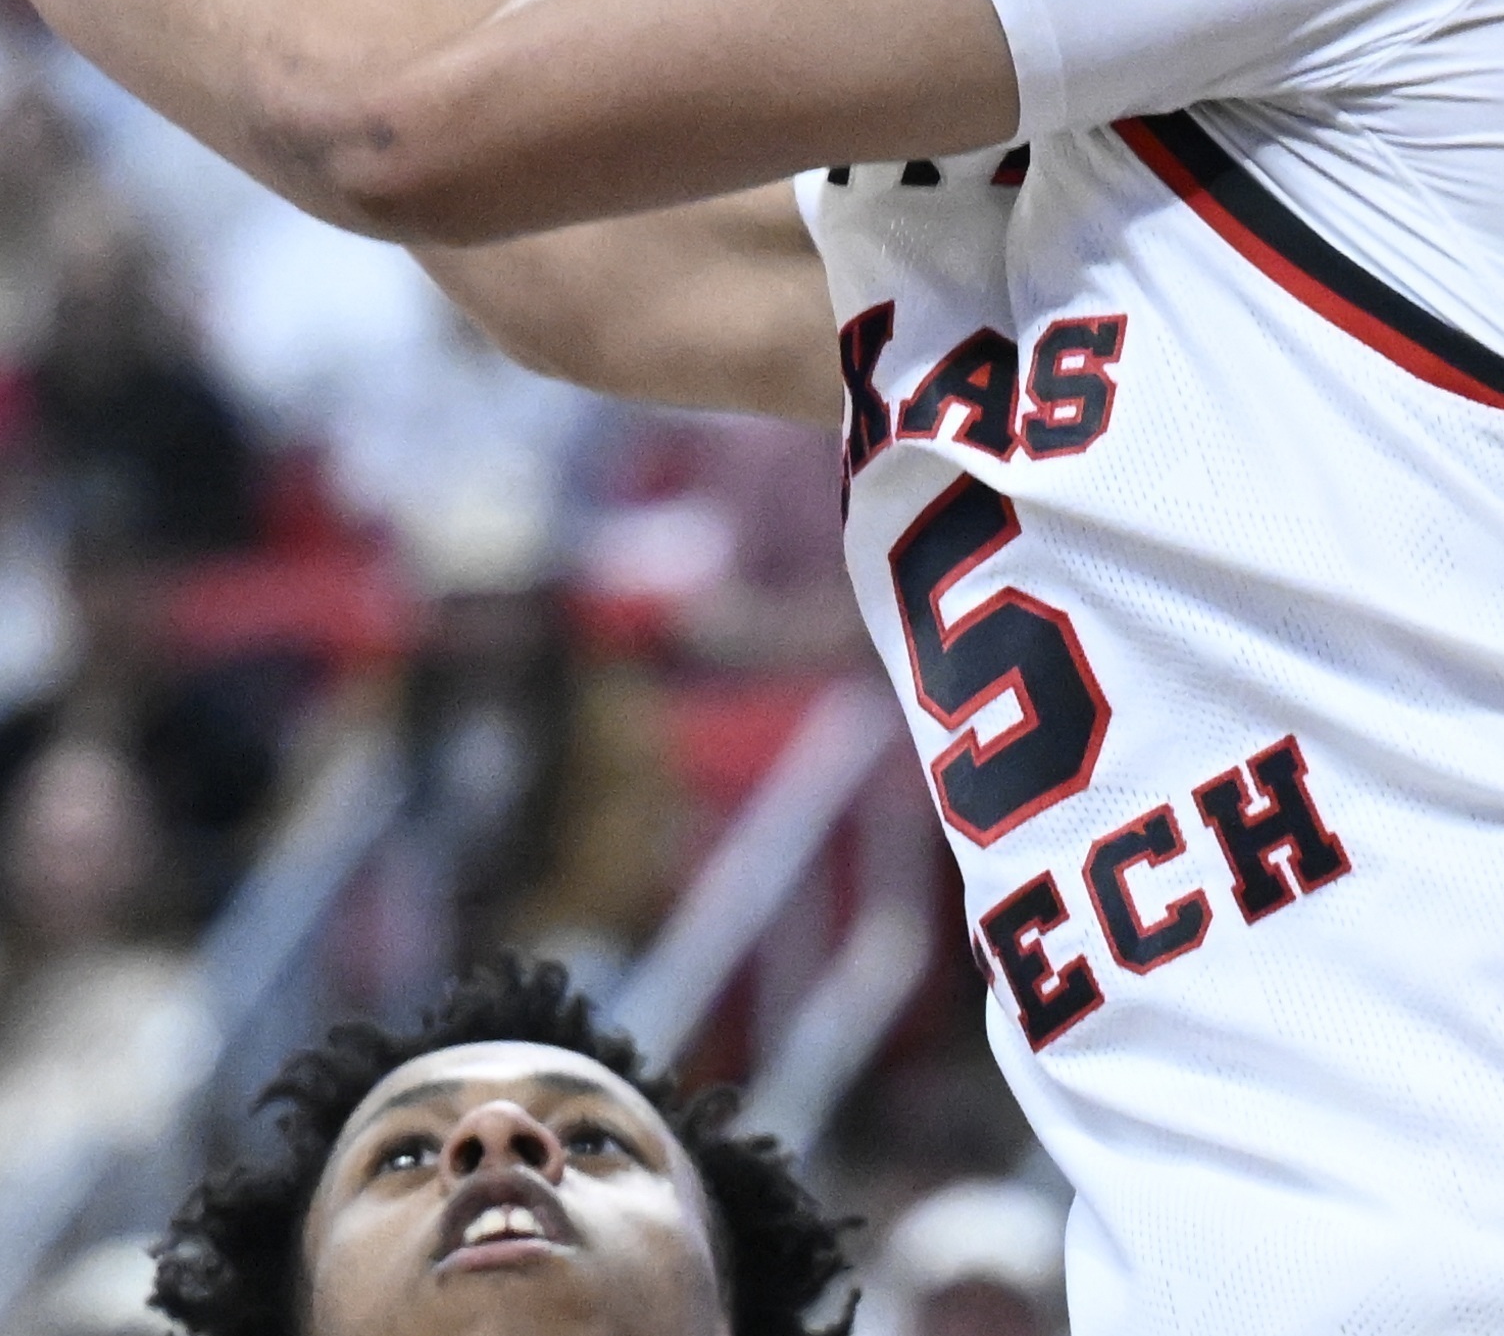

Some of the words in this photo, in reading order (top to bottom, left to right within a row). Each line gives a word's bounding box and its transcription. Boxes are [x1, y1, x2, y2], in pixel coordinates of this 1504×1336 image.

[840, 299, 1128, 481] XAS
[888, 471, 1112, 849] 5
[972, 734, 1352, 1053] ECH
